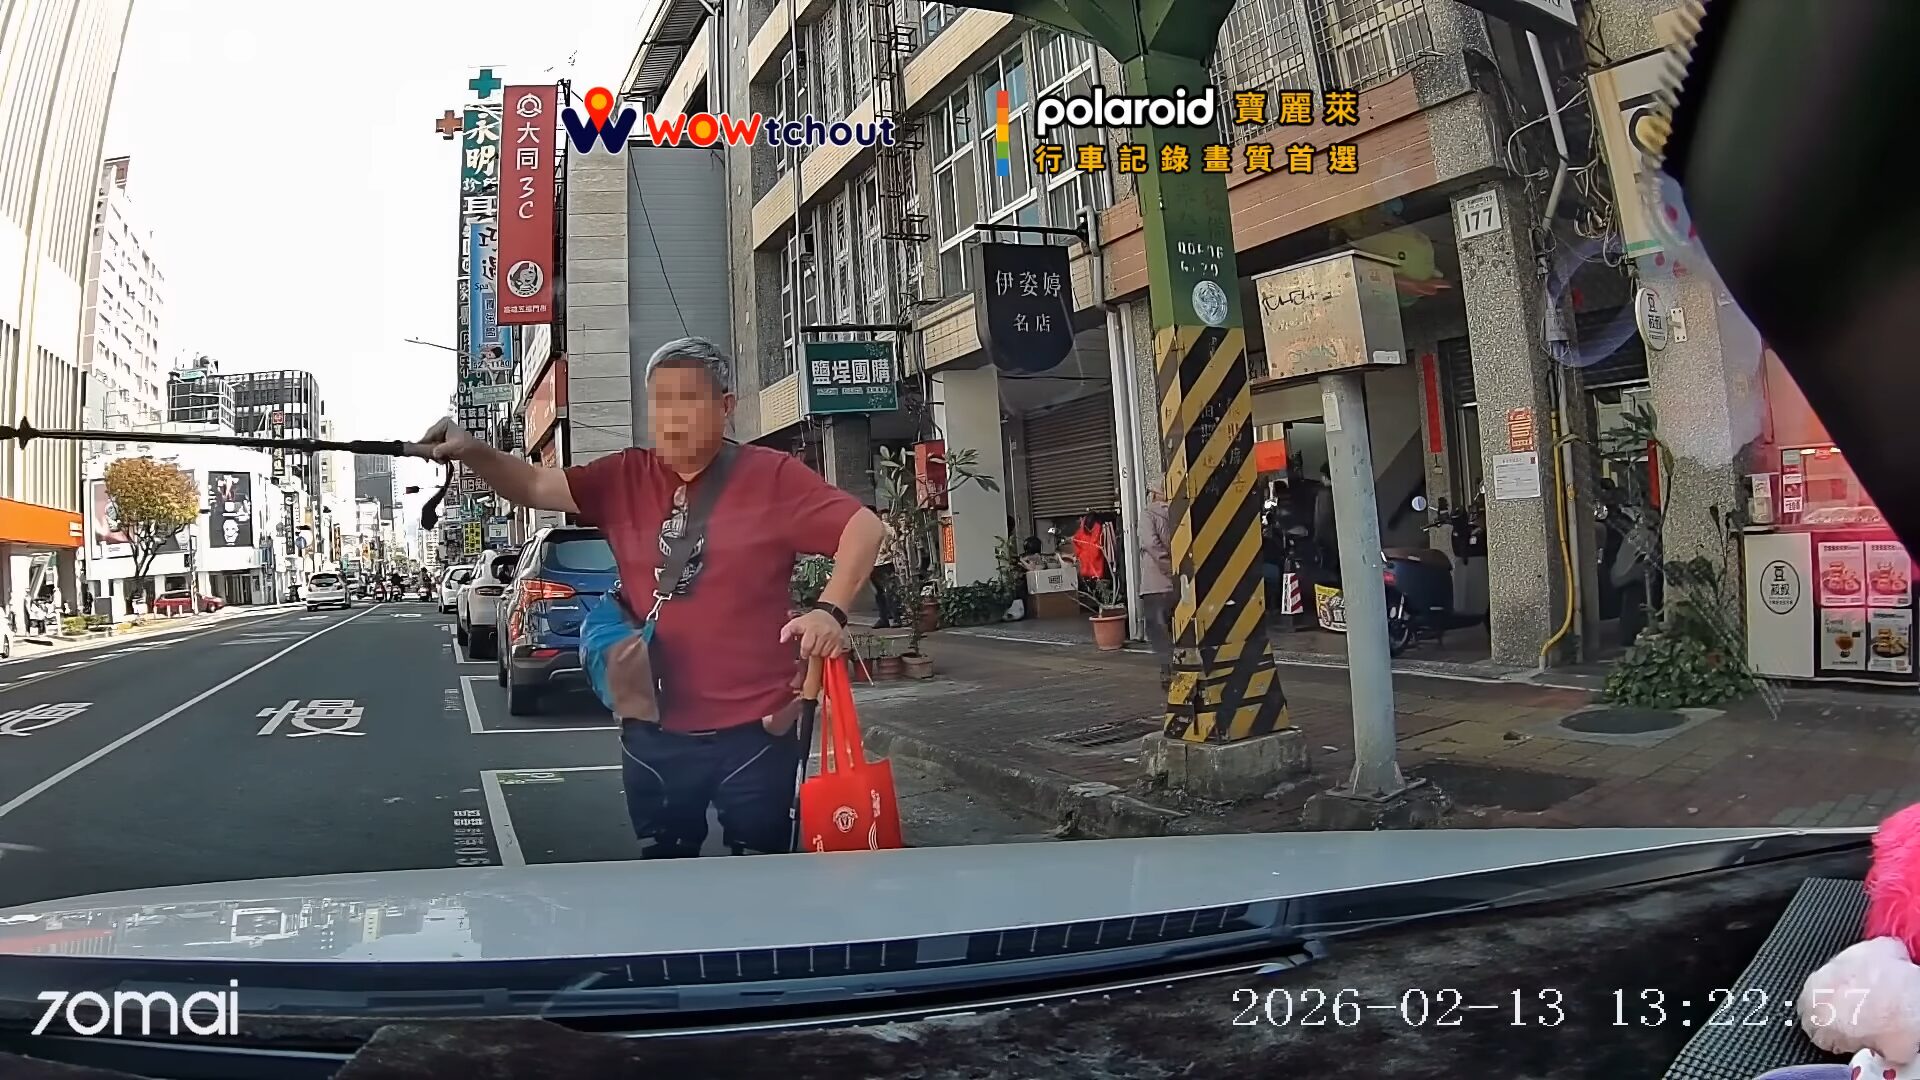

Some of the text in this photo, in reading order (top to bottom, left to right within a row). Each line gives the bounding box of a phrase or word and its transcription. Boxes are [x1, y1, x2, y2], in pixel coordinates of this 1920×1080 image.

[1465, 207, 1493, 232] 177
[995, 269, 1062, 298] 伊姿婷
[1013, 313, 1051, 333] 名店
[811, 359, 891, 385] 鹽埕團購
[256, 699, 367, 738] 慢
